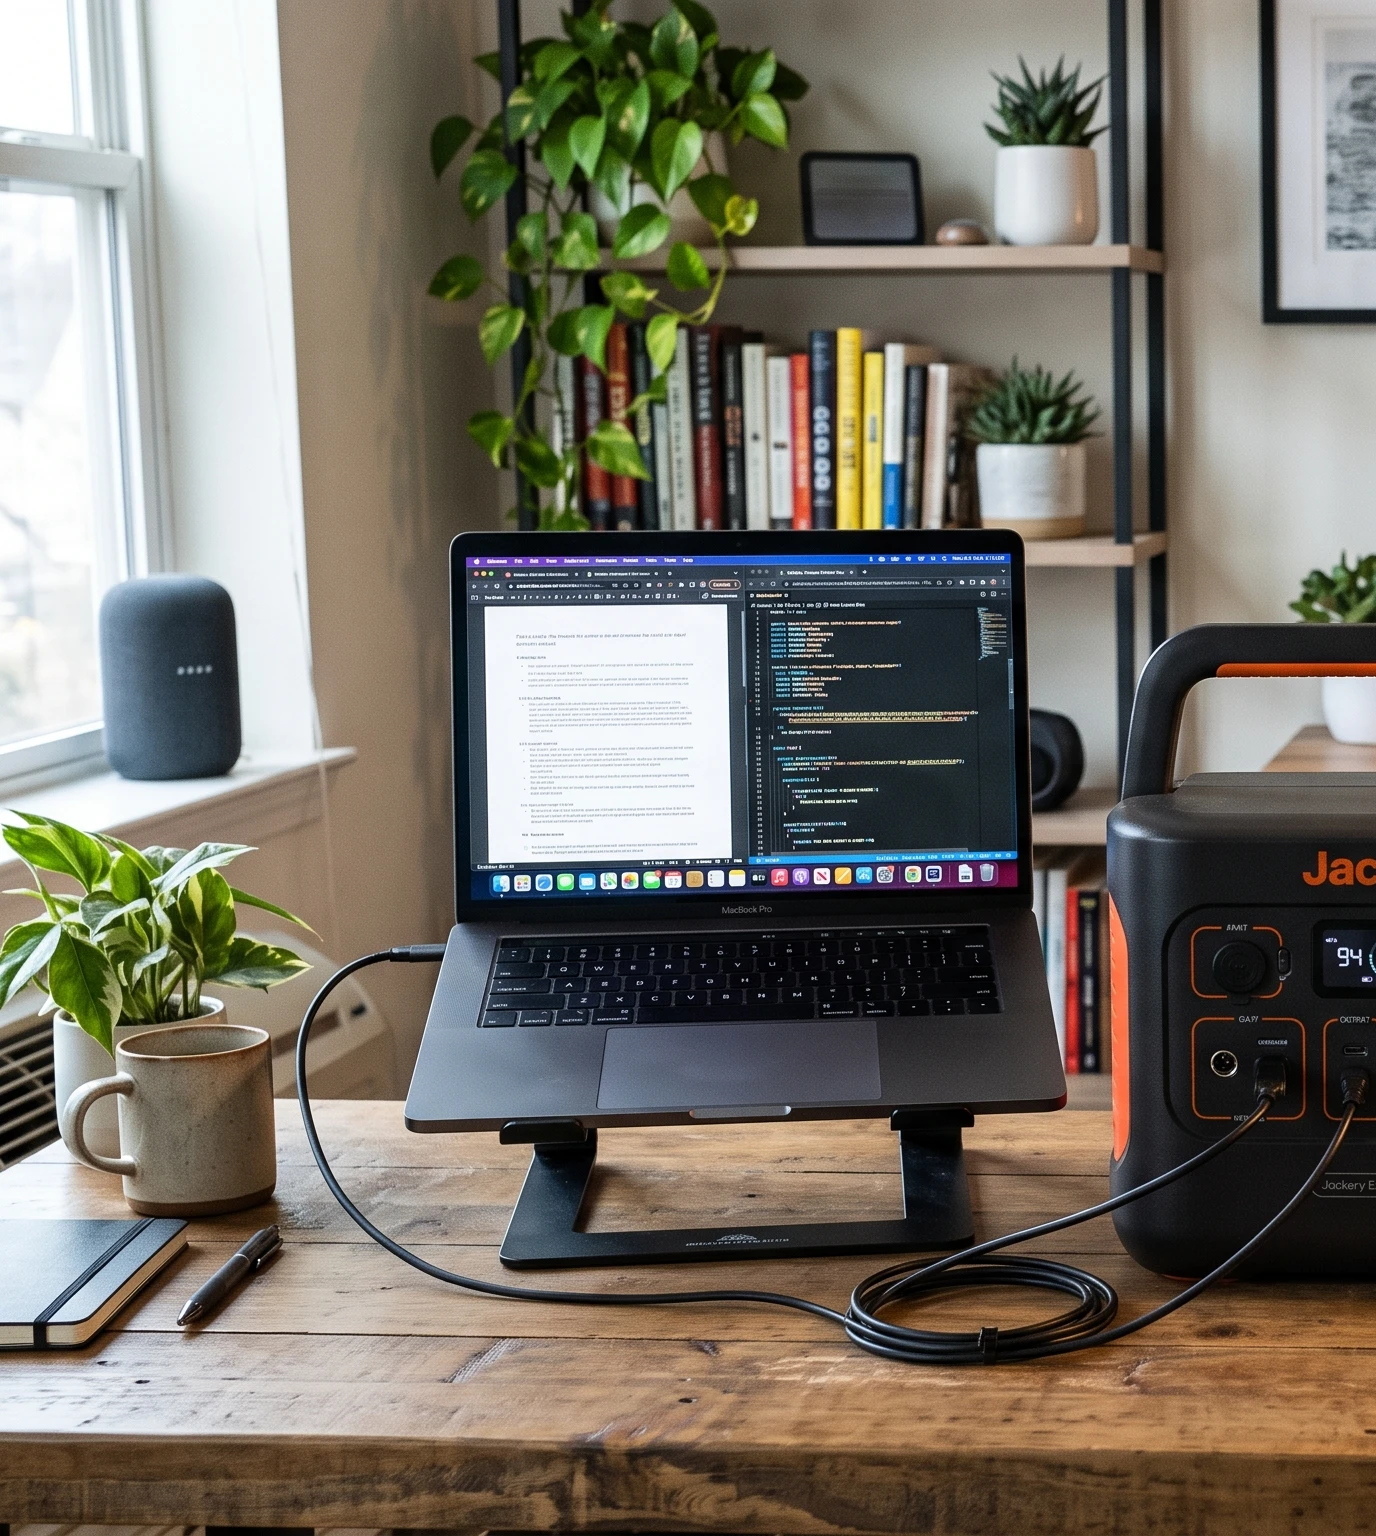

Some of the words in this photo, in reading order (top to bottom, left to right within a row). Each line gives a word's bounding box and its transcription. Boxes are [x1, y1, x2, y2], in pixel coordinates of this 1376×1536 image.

[758, 904, 773, 913] Pro
[1337, 946, 1363, 967] 94
[1321, 1179, 1366, 1193] Jackery
